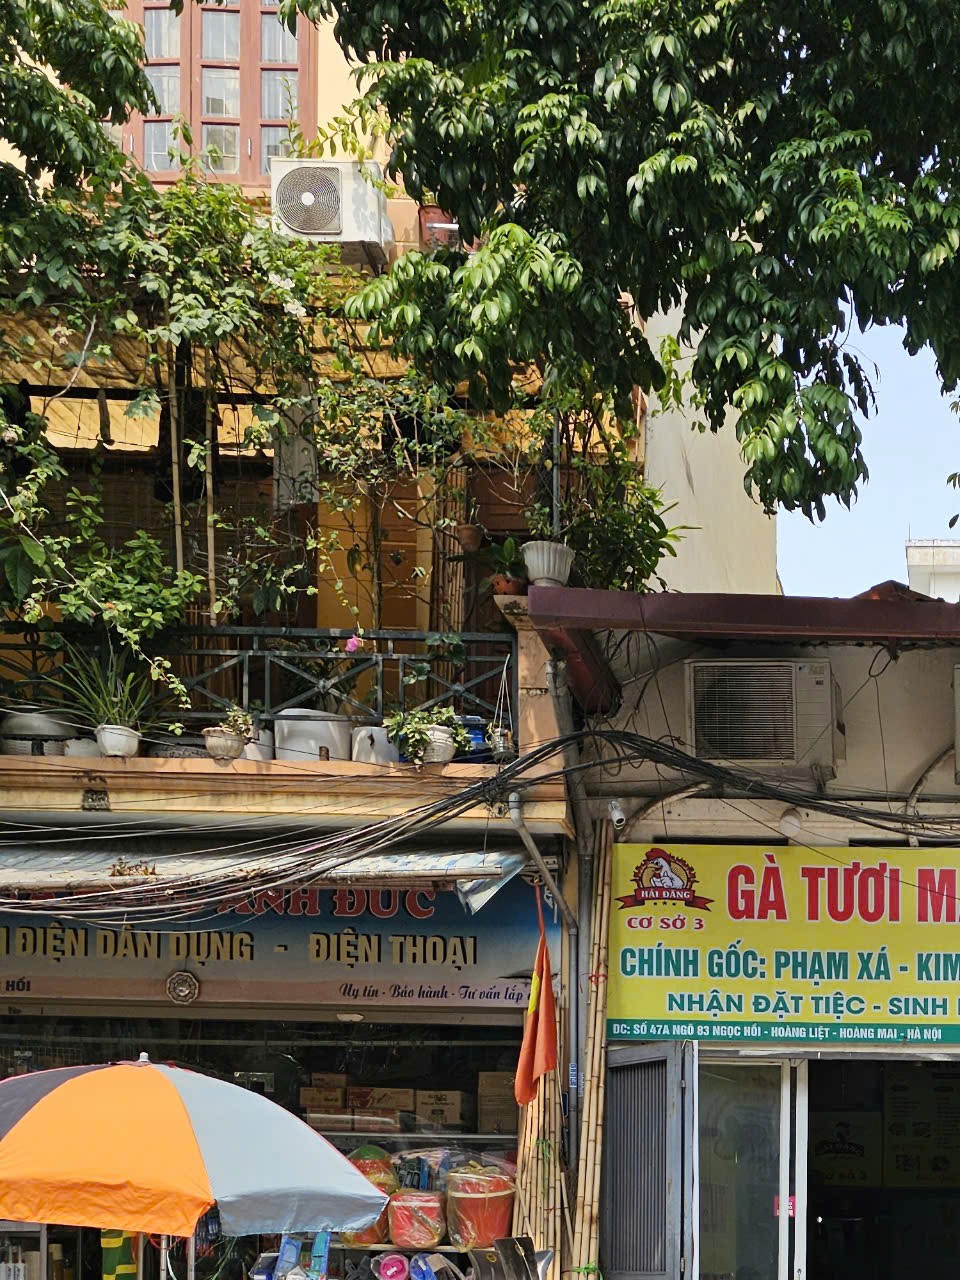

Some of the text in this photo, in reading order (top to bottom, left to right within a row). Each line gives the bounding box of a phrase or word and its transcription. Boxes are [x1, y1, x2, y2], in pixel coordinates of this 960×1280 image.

[727, 853, 788, 921] GÀ
[800, 861, 901, 923] TƯƠI
[626, 913, 705, 930] CƠ SỞ 3
[15, 921, 88, 962] ĐIỆN
[96, 925, 161, 960] DÂN
[168, 930, 255, 967] DỤNG
[308, 926, 382, 969] ĐIỆN
[388, 933, 478, 971] THOẠI
[620, 942, 699, 977] CHÍNH
[707, 939, 766, 979] GỐC:
[774, 951, 849, 986] PHẠM
[857, 946, 891, 981] XÁ
[362, 984, 379, 998] tín
[417, 985, 449, 999] hành
[667, 988, 744, 1018] NHẬN
[752, 990, 804, 1019] ĐẶT
[810, 992, 866, 1020] TIỆC
[888, 996, 948, 1016] SINH
[612, 1023, 631, 1035] ĐC:
[633, 1020, 648, 1035] SỐ
[650, 1024, 670, 1036] 47A
[672, 1023, 695, 1036] NGÕ
[696, 1024, 710, 1036] 83
[712, 1025, 741, 1038] NGỌC
[771, 1025, 807, 1038] HOÀNG
[808, 1025, 830, 1041] LIỆT
[839, 1026, 875, 1039] HOÀNG
[877, 1027, 898, 1039] MAI
[907, 1026, 922, 1040] HÀ
[923, 1027, 942, 1042] NỘI
